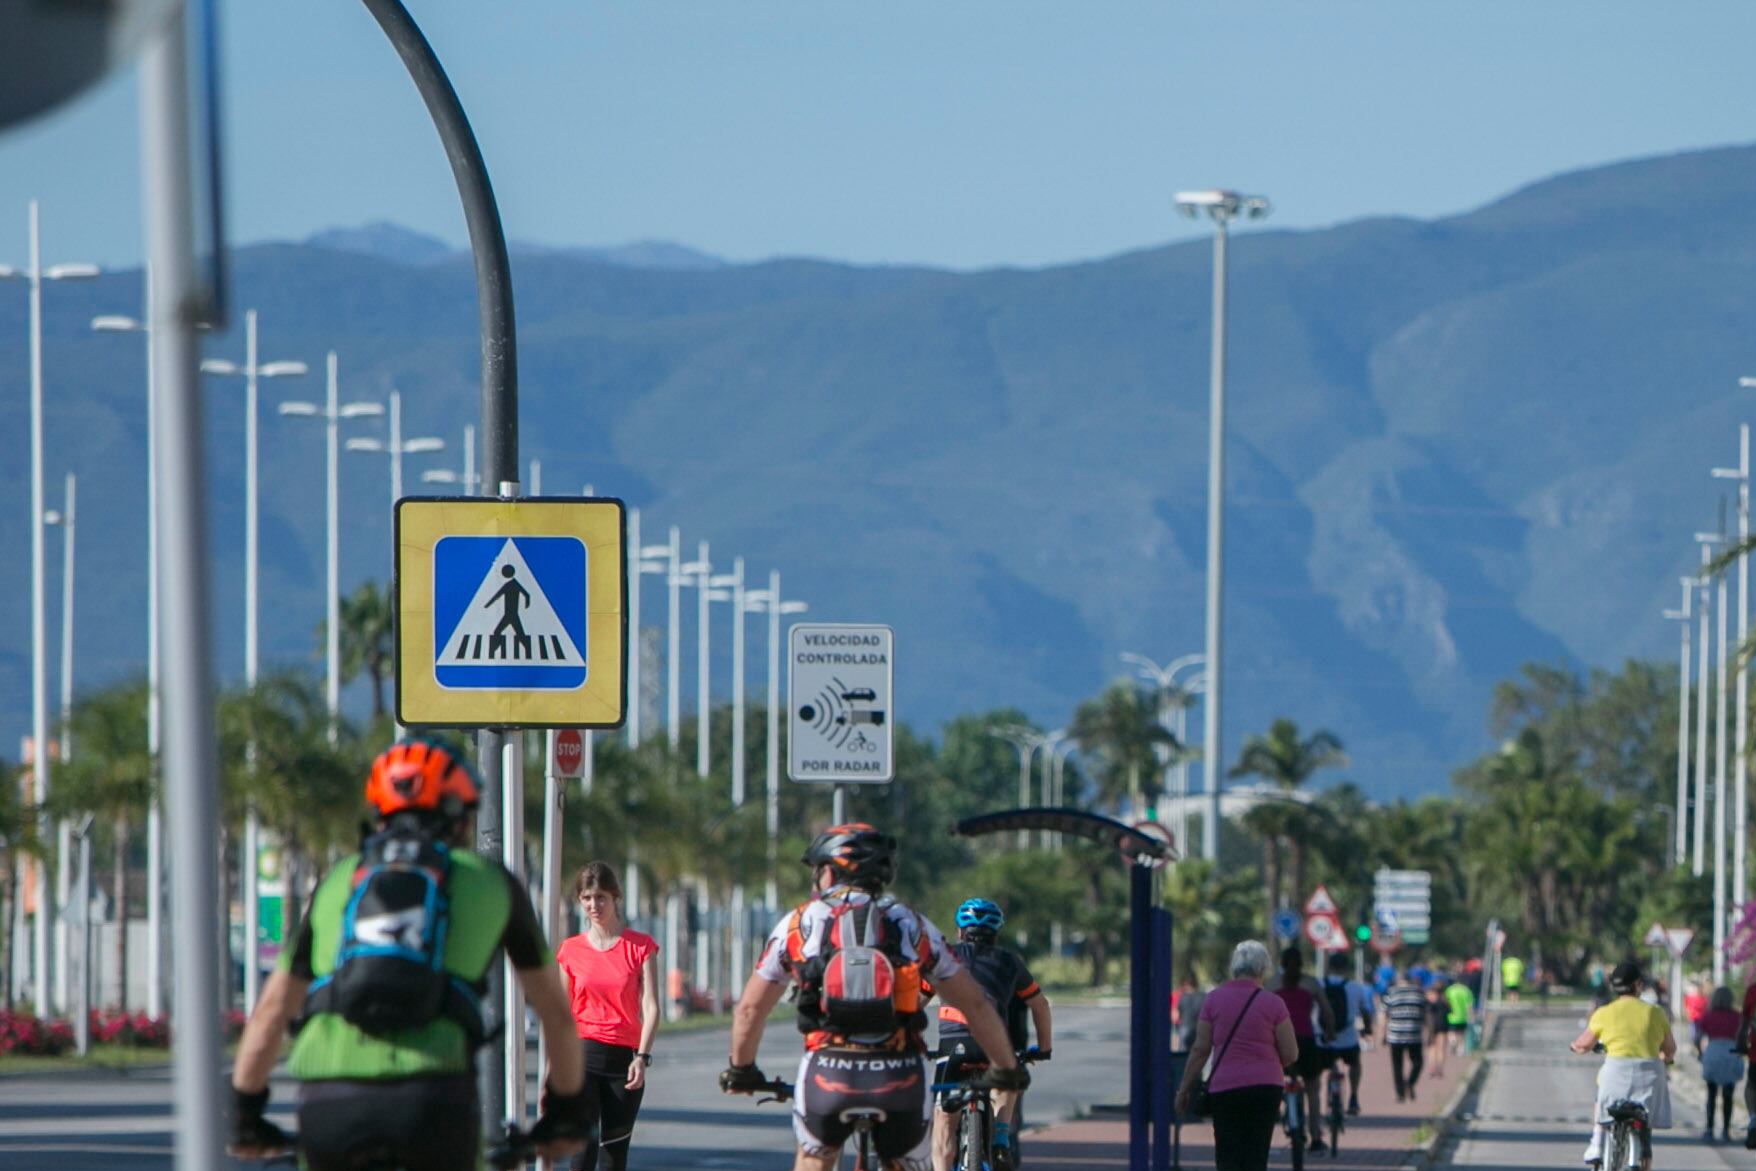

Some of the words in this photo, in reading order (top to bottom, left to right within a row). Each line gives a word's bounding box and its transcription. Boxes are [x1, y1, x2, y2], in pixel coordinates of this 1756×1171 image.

[804, 634, 880, 646] VELOCIDAD
[797, 653, 887, 664] CONTROLADA
[558, 743, 581, 756] STOP
[802, 761, 830, 771] POR
[834, 761, 881, 771] RADAR
[817, 1055, 917, 1071] XINTOWN
